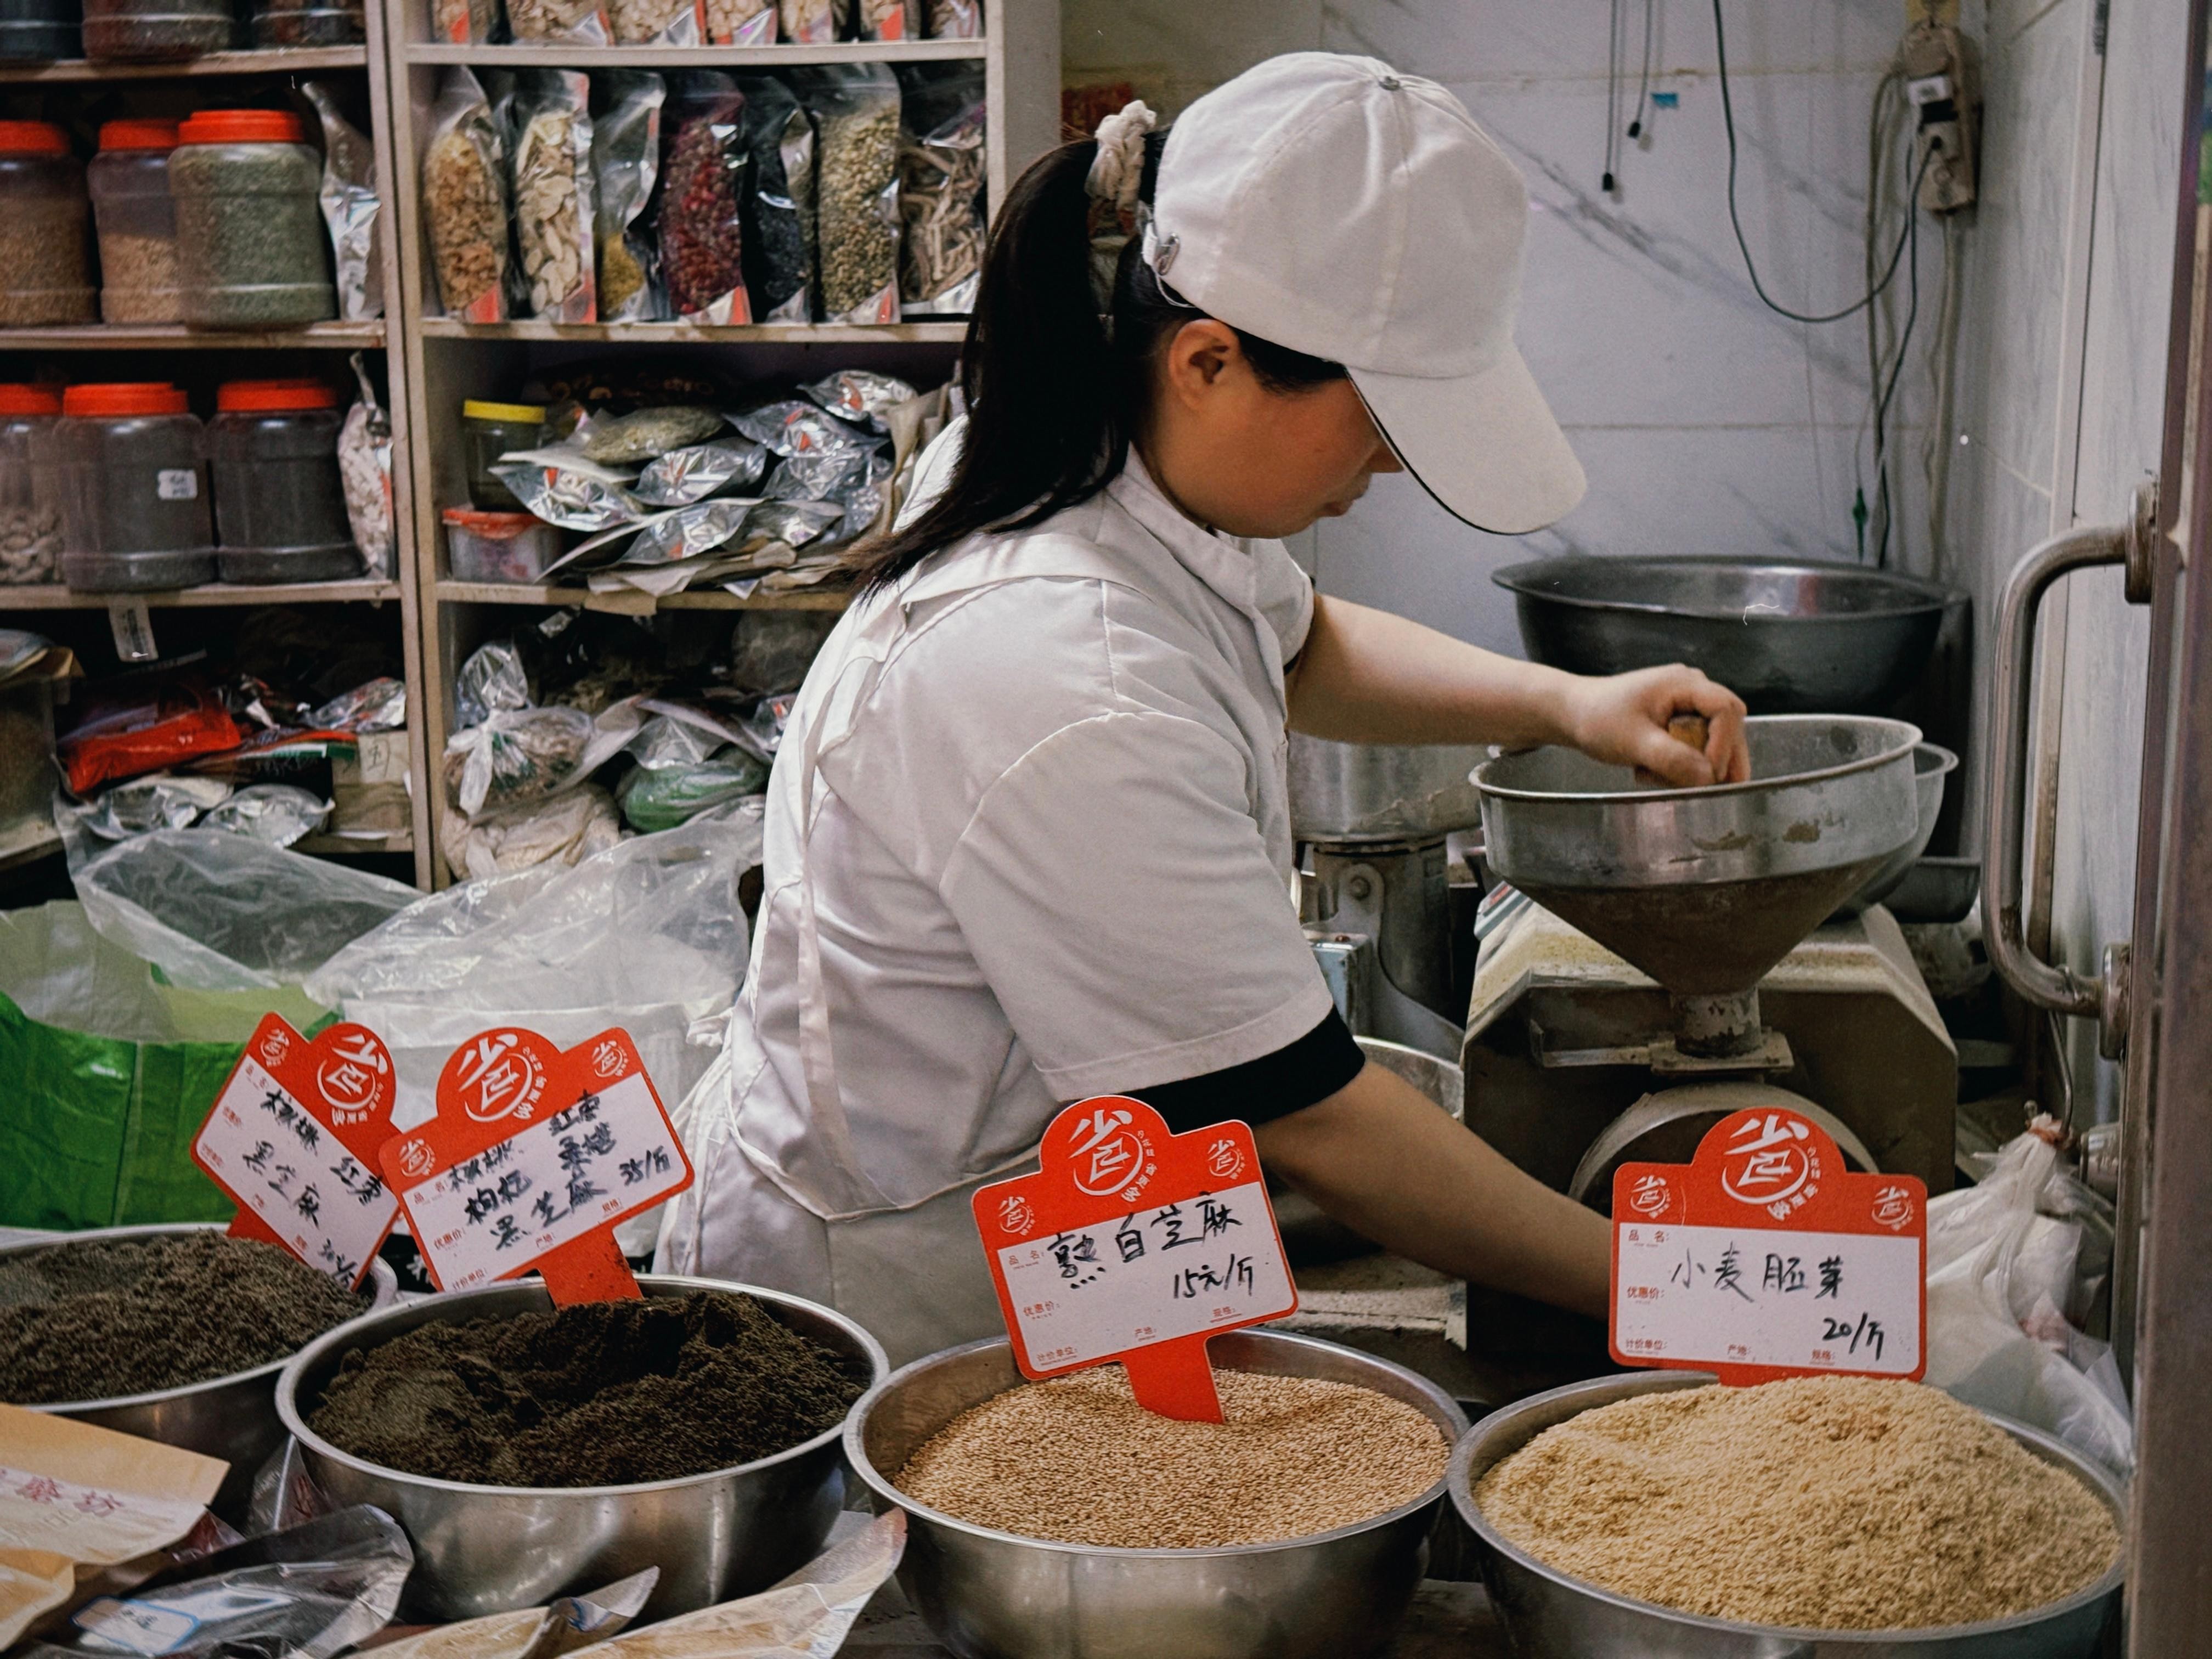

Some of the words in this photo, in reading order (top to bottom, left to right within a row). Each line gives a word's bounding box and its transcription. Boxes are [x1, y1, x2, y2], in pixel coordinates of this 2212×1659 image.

[242, 1140, 320, 1231] 黑芝麻
[489, 1163, 608, 1250] 黑芝麻
[1047, 1192, 1243, 1289] 熟白芝麻
[1174, 1254, 1253, 1299] 15元/斤
[1671, 1241, 1844, 1303] 小麦胚芽
[1822, 1312, 1884, 1361] 20/斤
